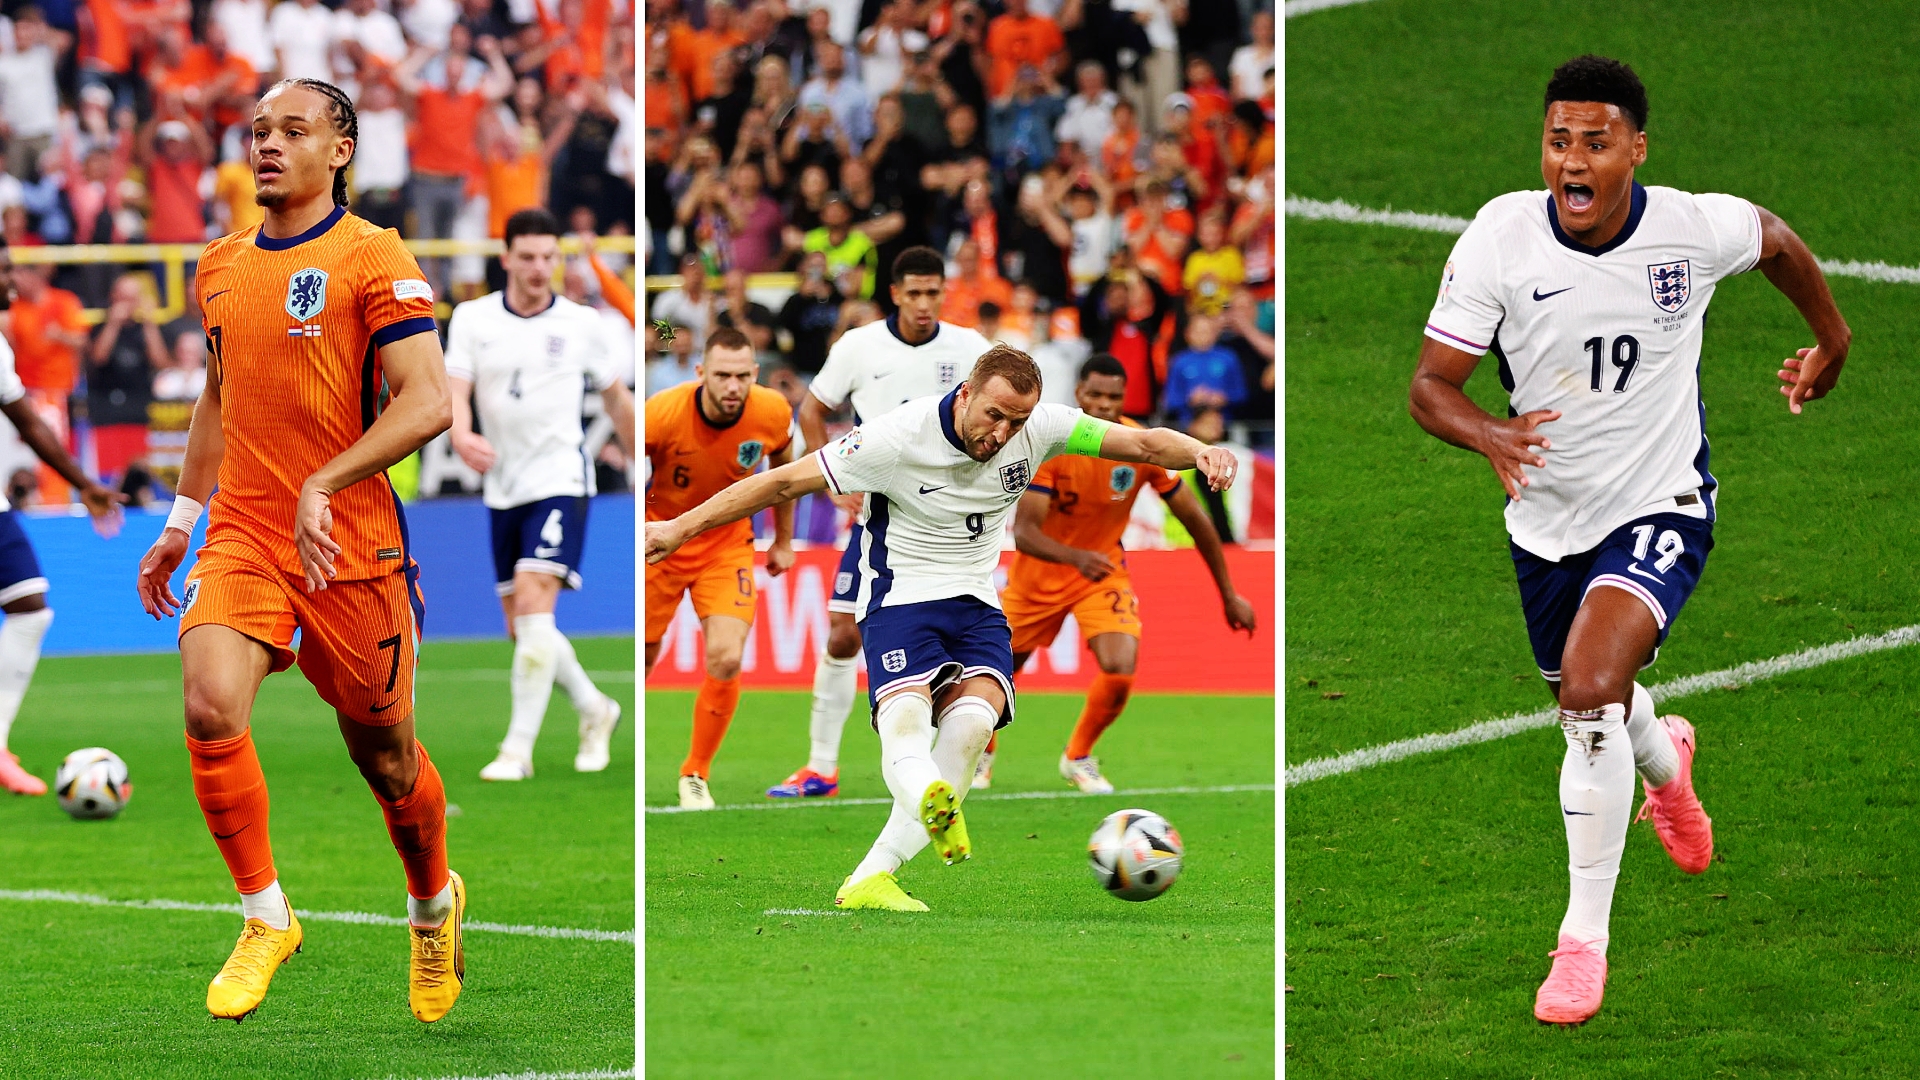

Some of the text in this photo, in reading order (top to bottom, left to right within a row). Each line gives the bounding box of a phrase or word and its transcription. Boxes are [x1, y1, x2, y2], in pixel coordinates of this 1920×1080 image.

[209, 325, 224, 386] 7
[1583, 334, 1641, 394] 19
[673, 465, 690, 489] 6
[540, 508, 564, 548] 4
[965, 512, 986, 543] 9
[1631, 524, 1685, 574] 19
[737, 567, 752, 597] 6
[377, 631, 401, 694] 7
